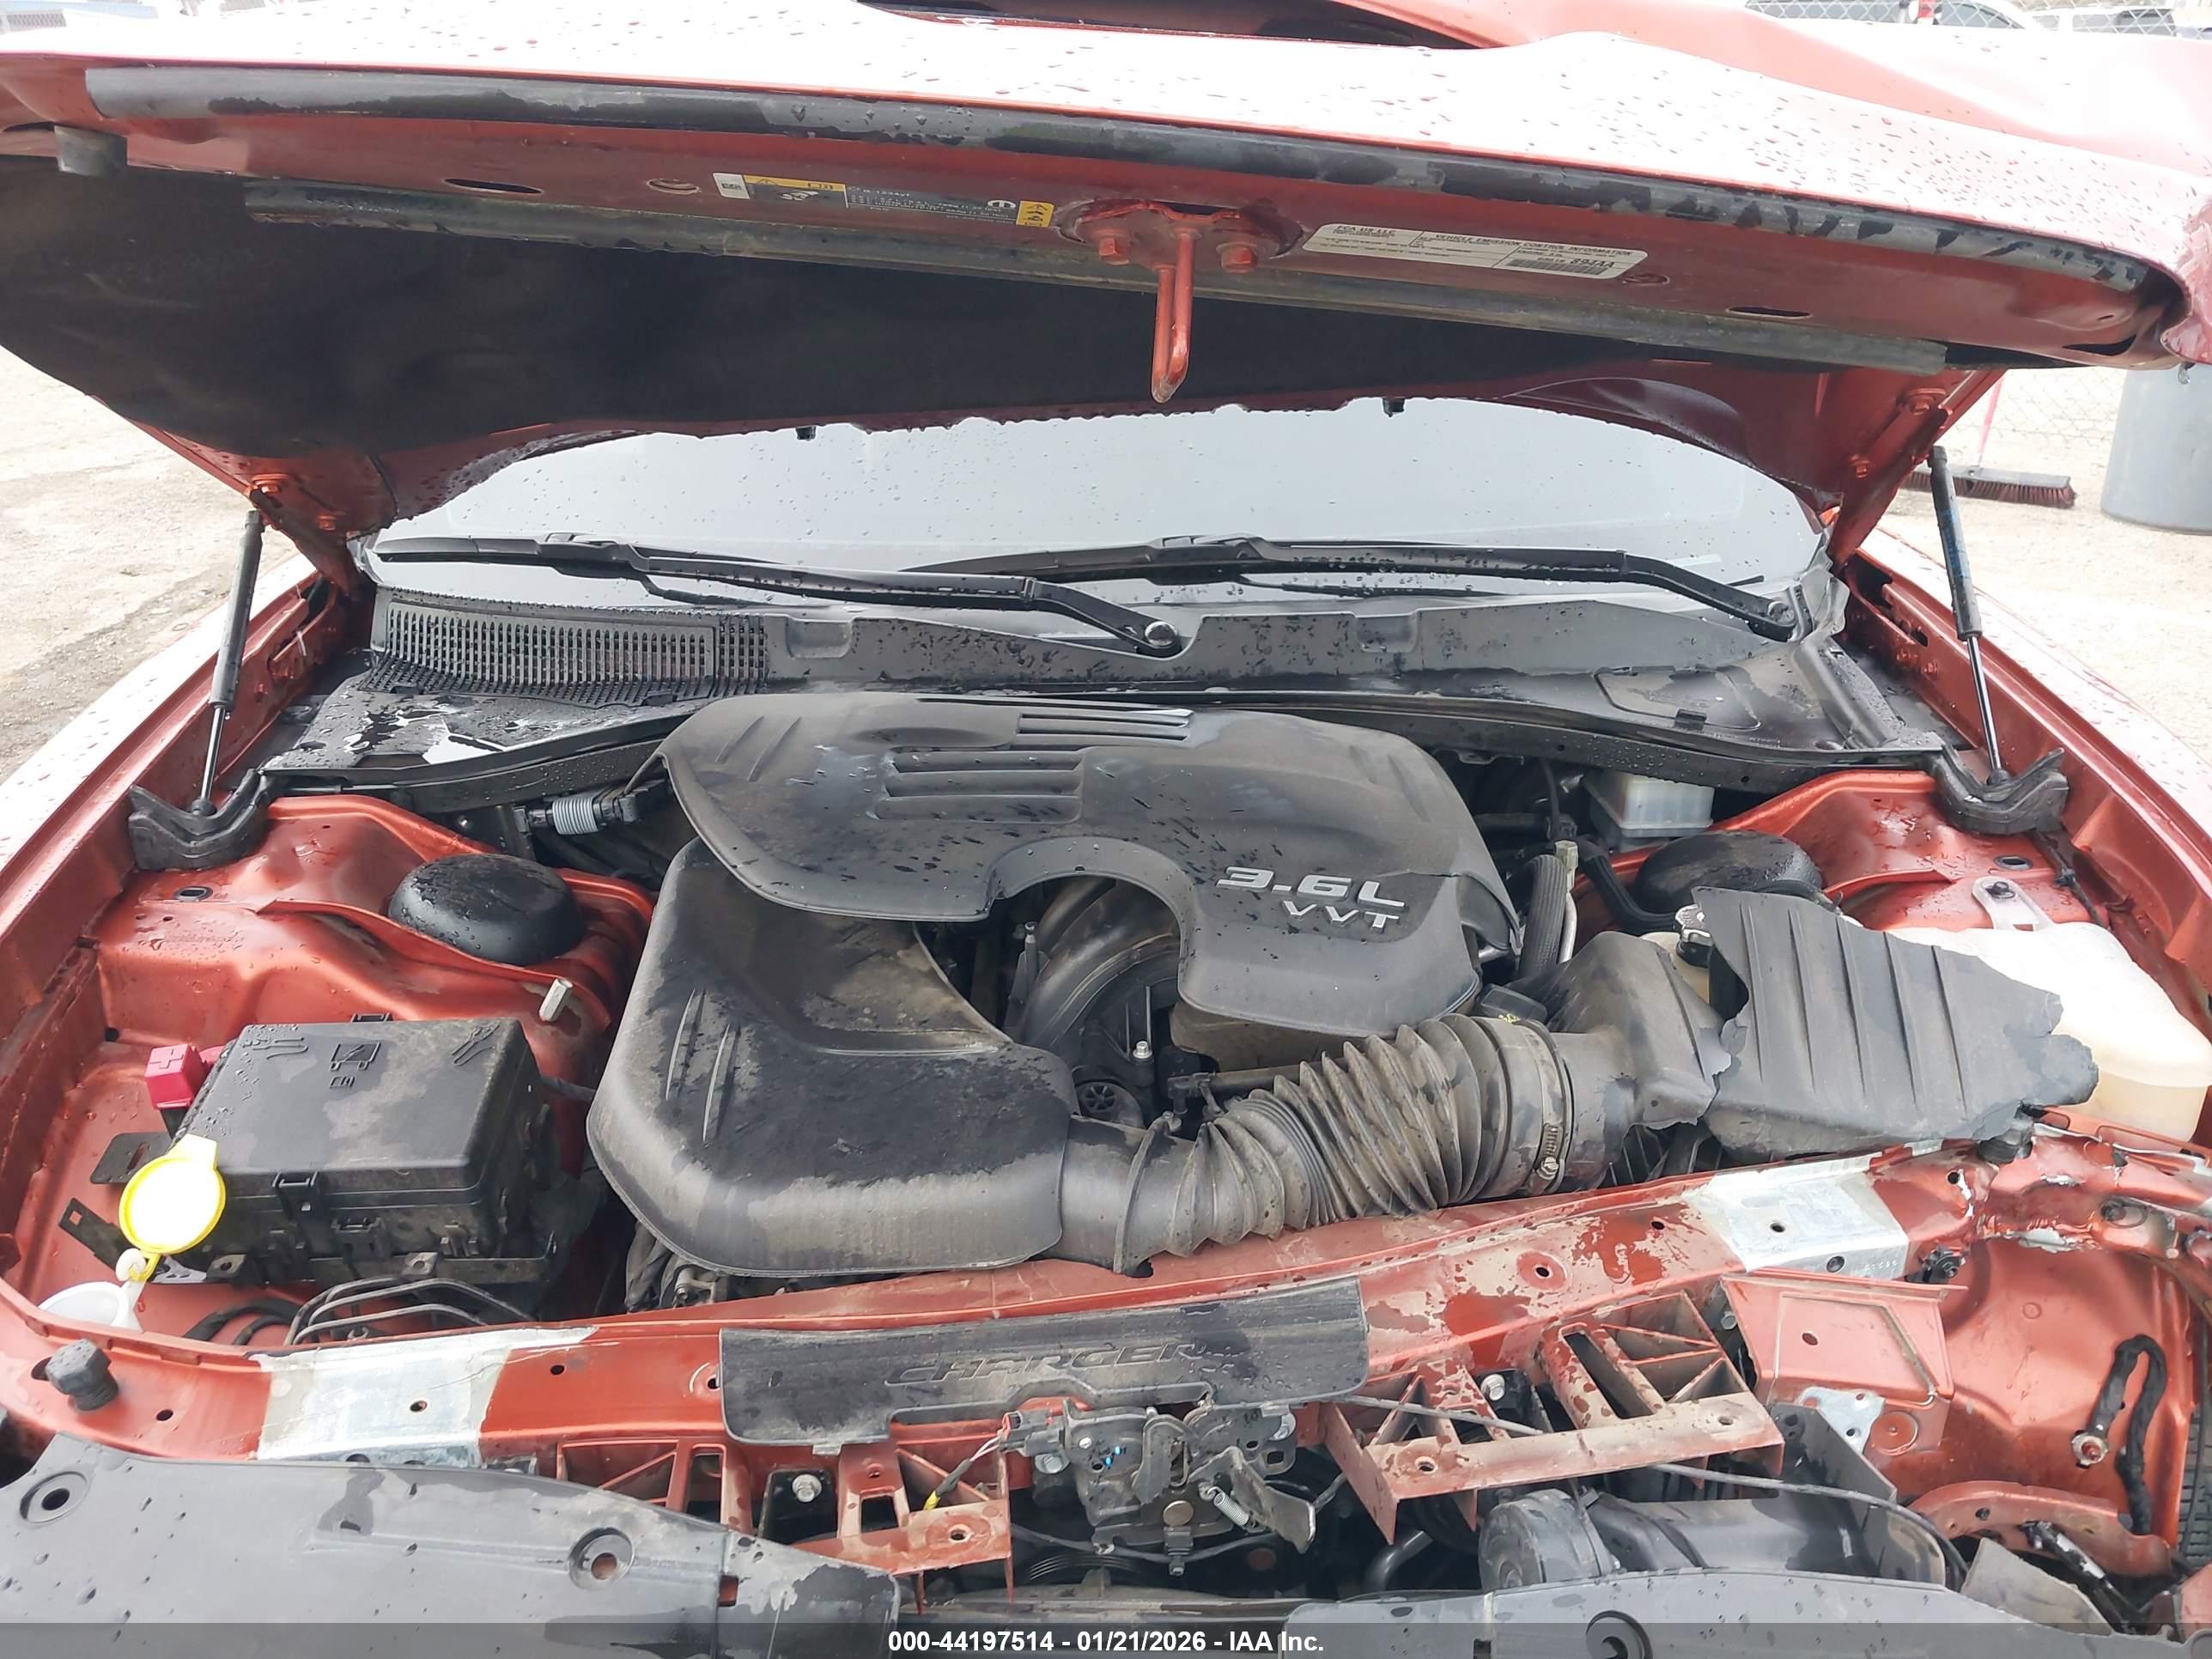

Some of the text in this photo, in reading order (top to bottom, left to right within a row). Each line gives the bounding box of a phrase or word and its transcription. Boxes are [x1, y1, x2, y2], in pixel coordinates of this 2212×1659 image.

[1476, 238, 1522, 246] EMISSION
[1523, 242, 1565, 251] CONTROL
[1569, 246, 1634, 257] INFORMATION
[1216, 866, 1407, 911] 3.6L
[1281, 900, 1401, 933] VVT
[884, 1342, 1204, 1387] CHARGER
